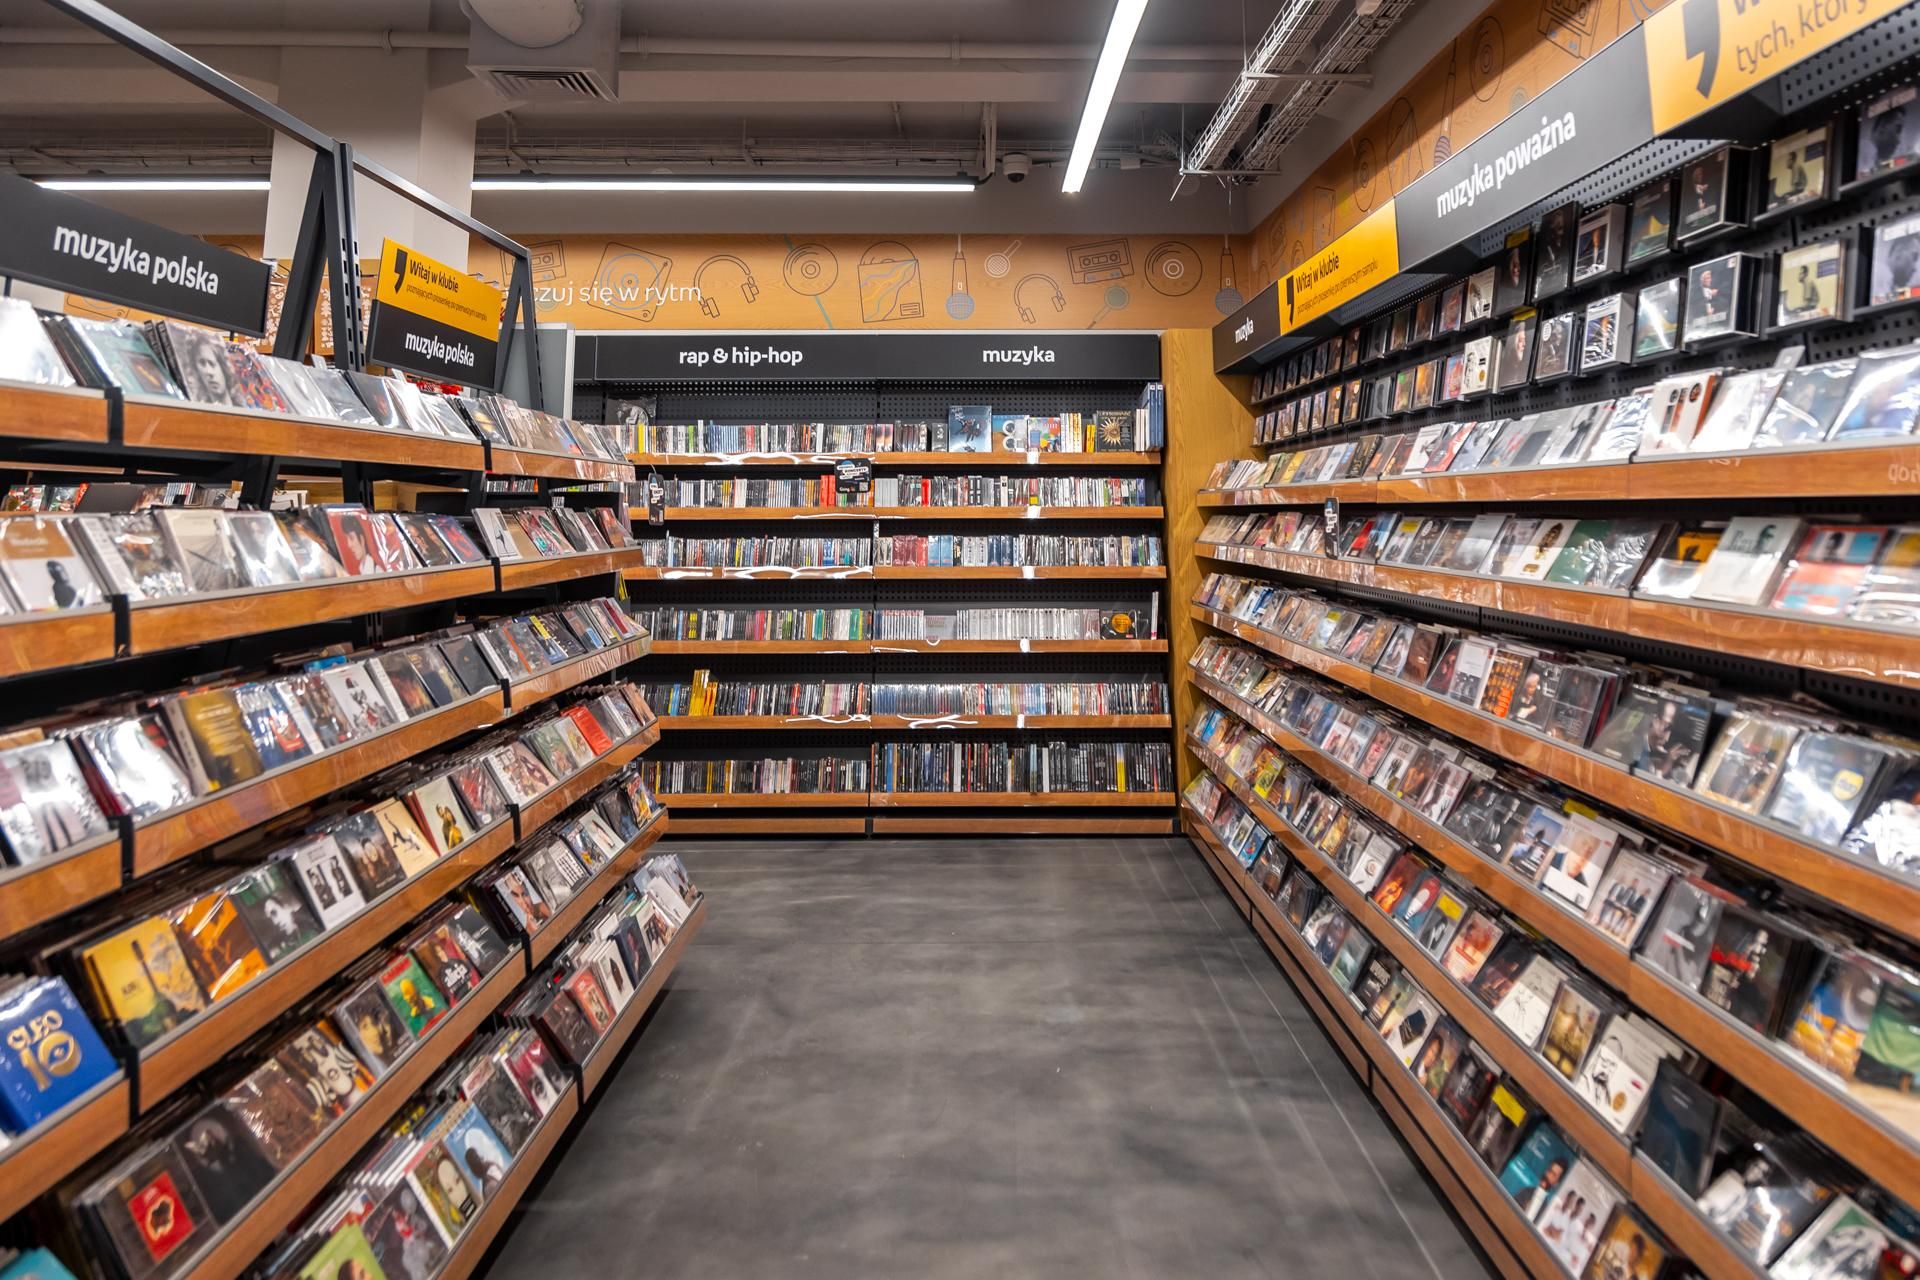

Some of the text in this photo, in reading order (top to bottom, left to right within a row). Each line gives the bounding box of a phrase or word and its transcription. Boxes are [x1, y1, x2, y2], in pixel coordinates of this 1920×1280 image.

[1736, 19, 1795, 74] tych,
[1436, 111, 1576, 218] muzyka poważna
[53, 226, 219, 295] muzyka polska
[410, 259, 459, 293] Witaj w klubie
[1296, 251, 1340, 293] Witaj w klubie
[579, 280, 613, 306] się
[619, 287, 640, 301] w
[645, 283, 701, 306] rytm
[1235, 316, 1254, 344] muzyka
[405, 332, 475, 367] muzyka polska
[679, 346, 803, 367] rap & hip-hop
[983, 345, 1055, 366] muzyka
[7, 1009, 63, 1050] CLEO
